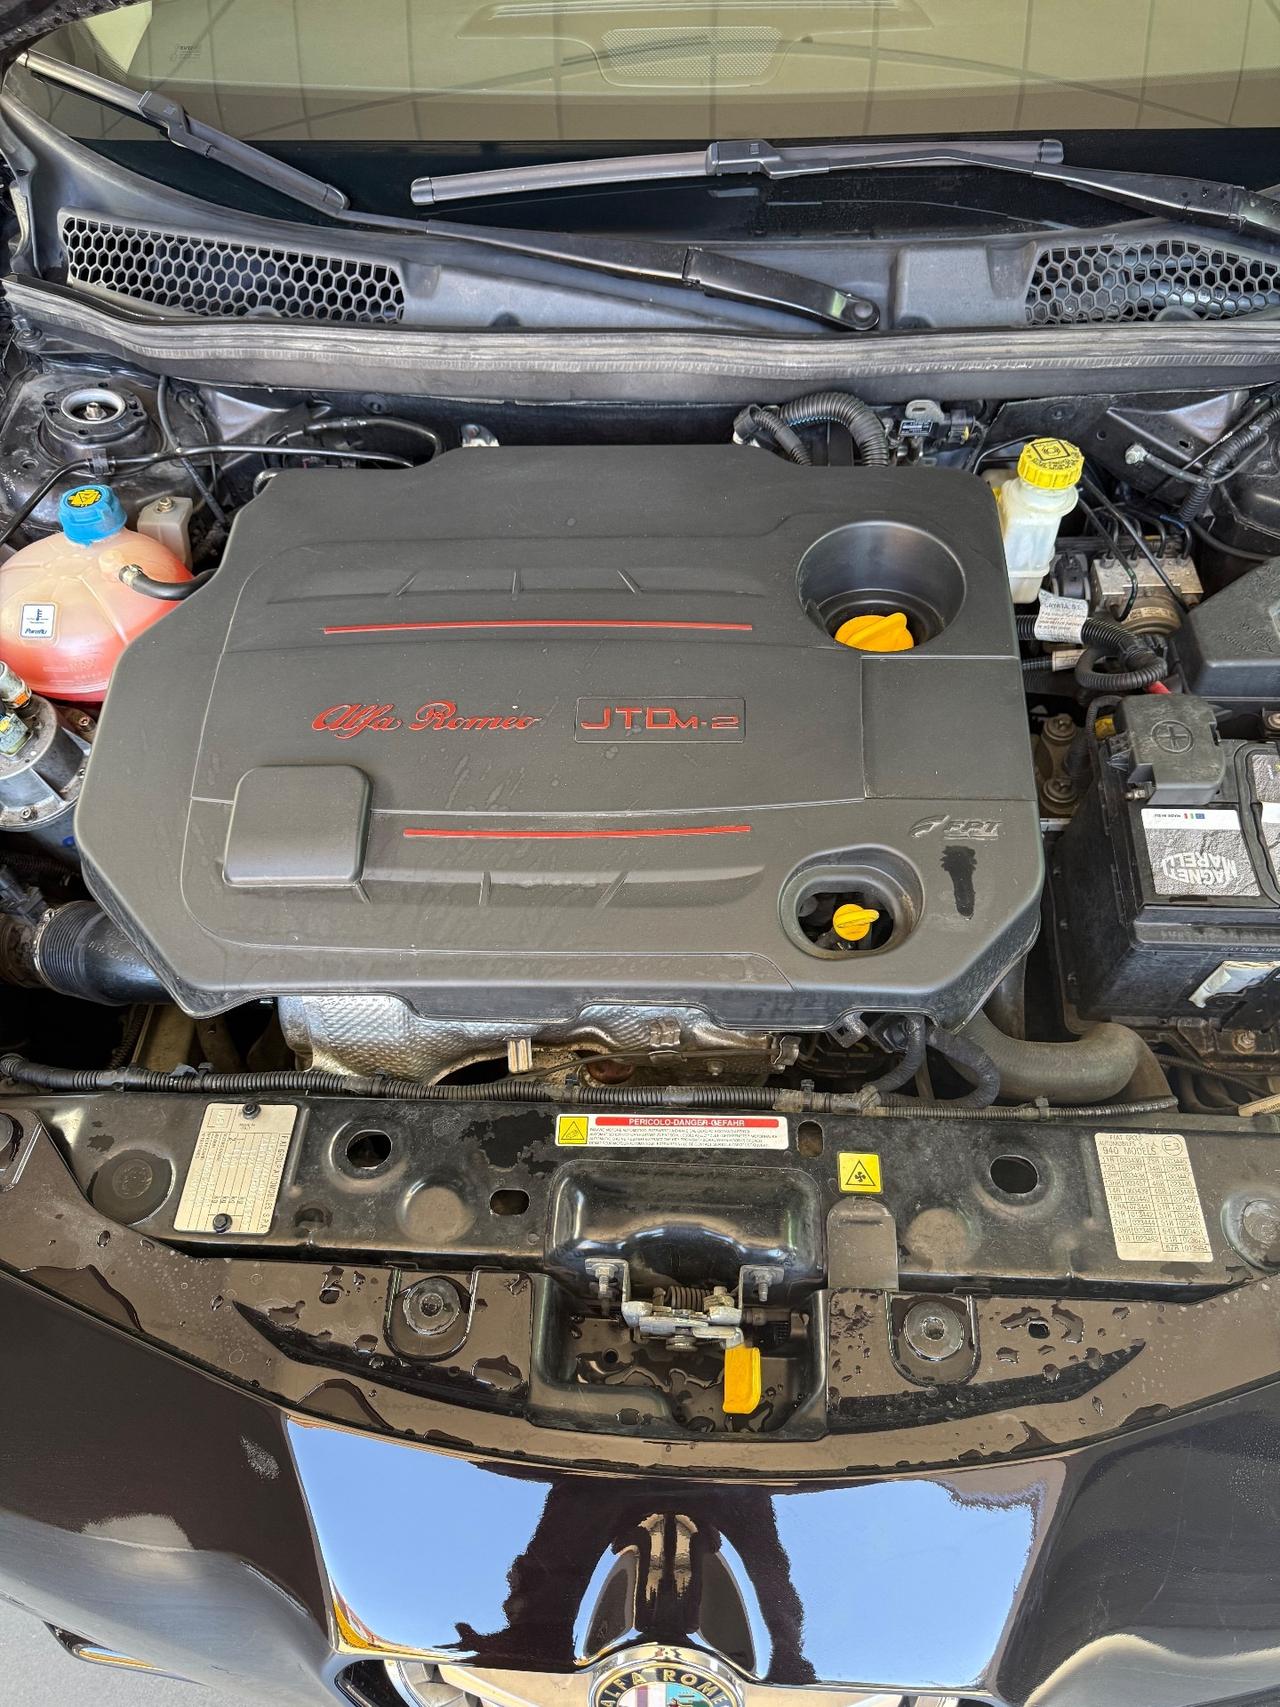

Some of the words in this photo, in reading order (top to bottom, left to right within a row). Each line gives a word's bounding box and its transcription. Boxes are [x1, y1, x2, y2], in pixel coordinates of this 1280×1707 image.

[311, 703, 404, 740] Alfa
[408, 700, 541, 732] Romeo
[1161, 864, 1237, 885] MAGNETI
[629, 1118, 745, 1127] PERICOLO-DANGER-GEFAHR
[1102, 1146, 1119, 1154] 940
[1123, 1146, 1156, 1155] MODELS
